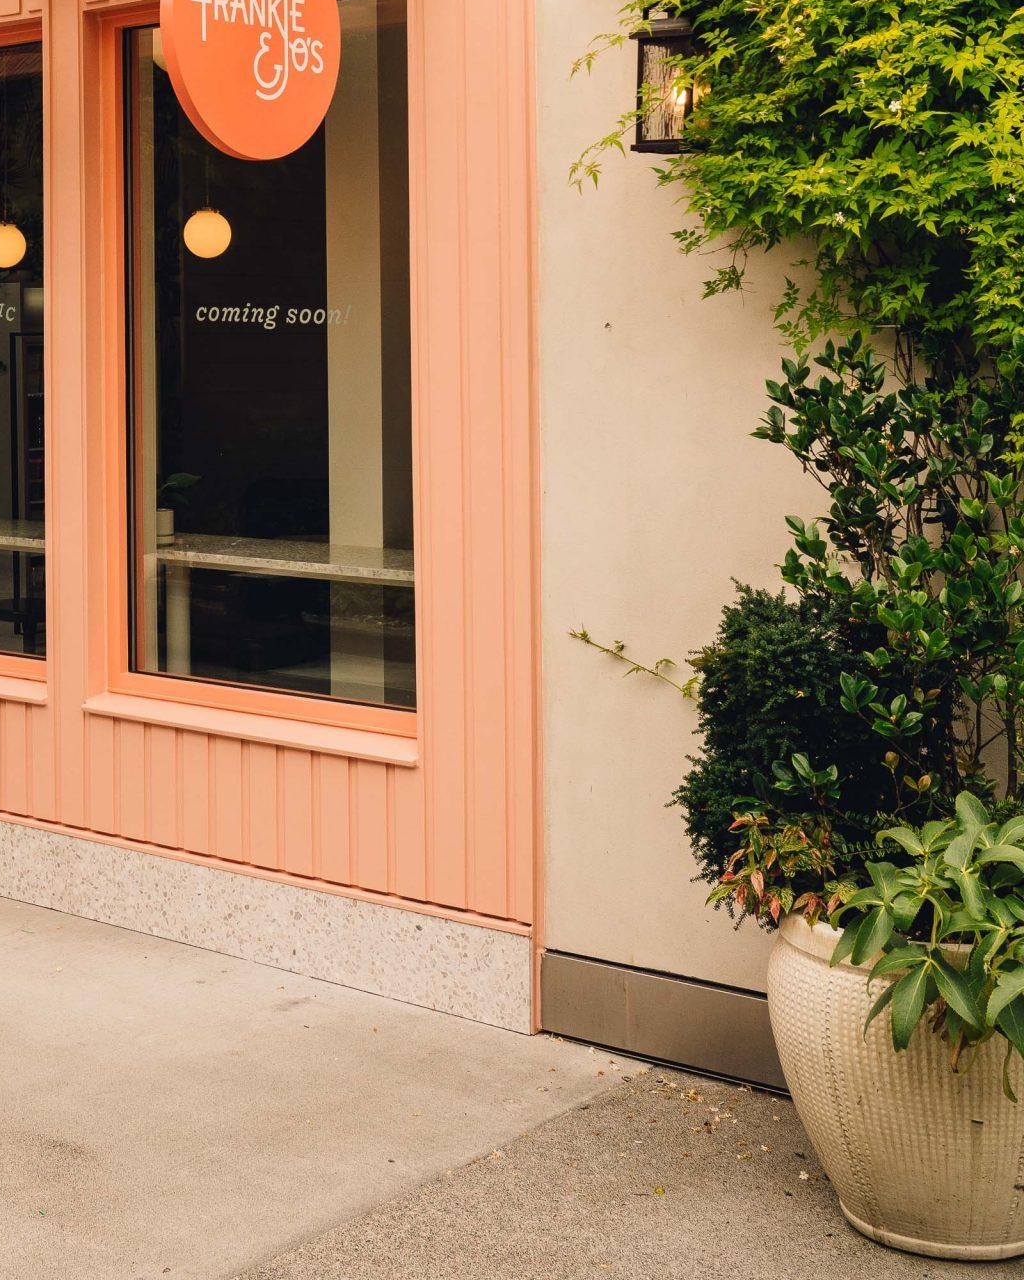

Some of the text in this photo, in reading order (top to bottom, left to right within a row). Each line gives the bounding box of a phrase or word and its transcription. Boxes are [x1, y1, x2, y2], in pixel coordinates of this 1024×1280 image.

[253, 31, 283, 89] &
[195, 302, 353, 330] coming soon!
